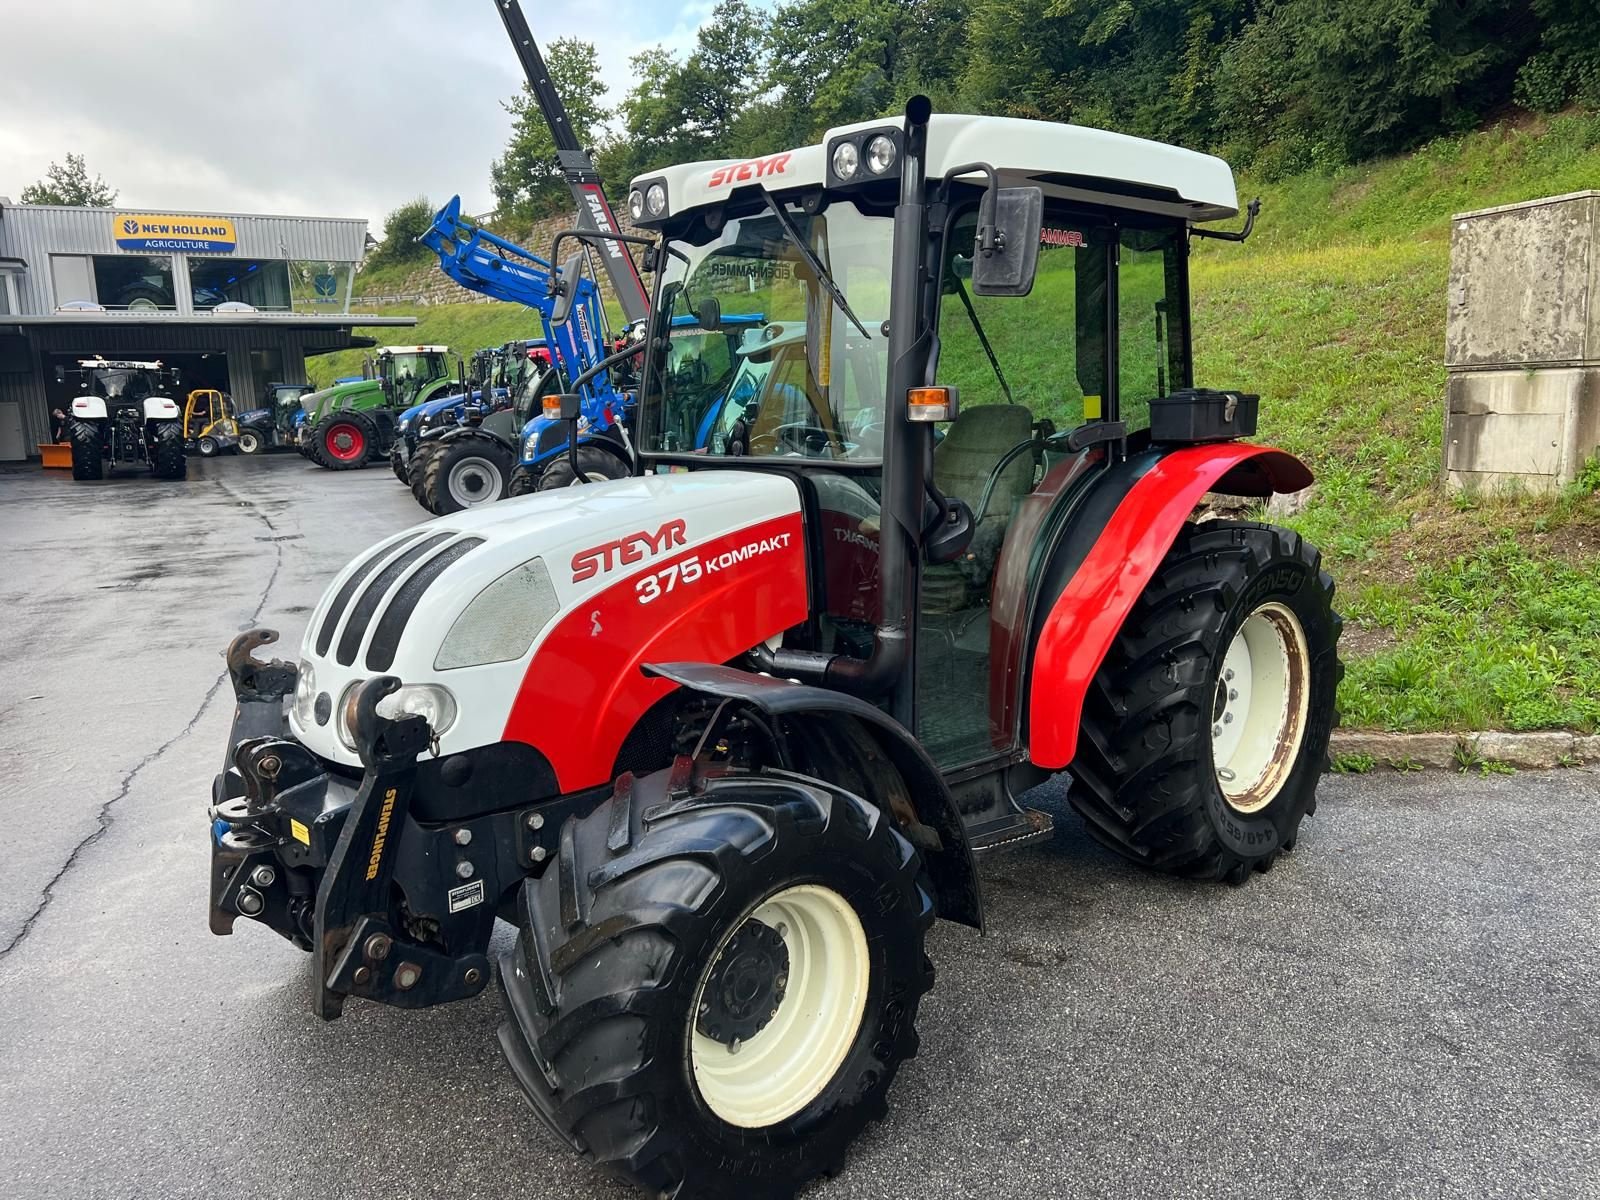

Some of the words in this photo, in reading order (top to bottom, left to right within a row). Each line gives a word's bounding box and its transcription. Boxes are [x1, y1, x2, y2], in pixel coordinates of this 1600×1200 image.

[708, 154, 791, 188] STEYR
[142, 224, 169, 234] NEW
[172, 225, 227, 236] HOLLAND
[145, 240, 210, 249] AGRICULTURE
[585, 194, 623, 259] FAREIN
[571, 518, 688, 583] STEYR
[635, 556, 703, 604] 375
[705, 533, 791, 574] KOMPAKT
[365, 788, 397, 881] STEMPLINGER
